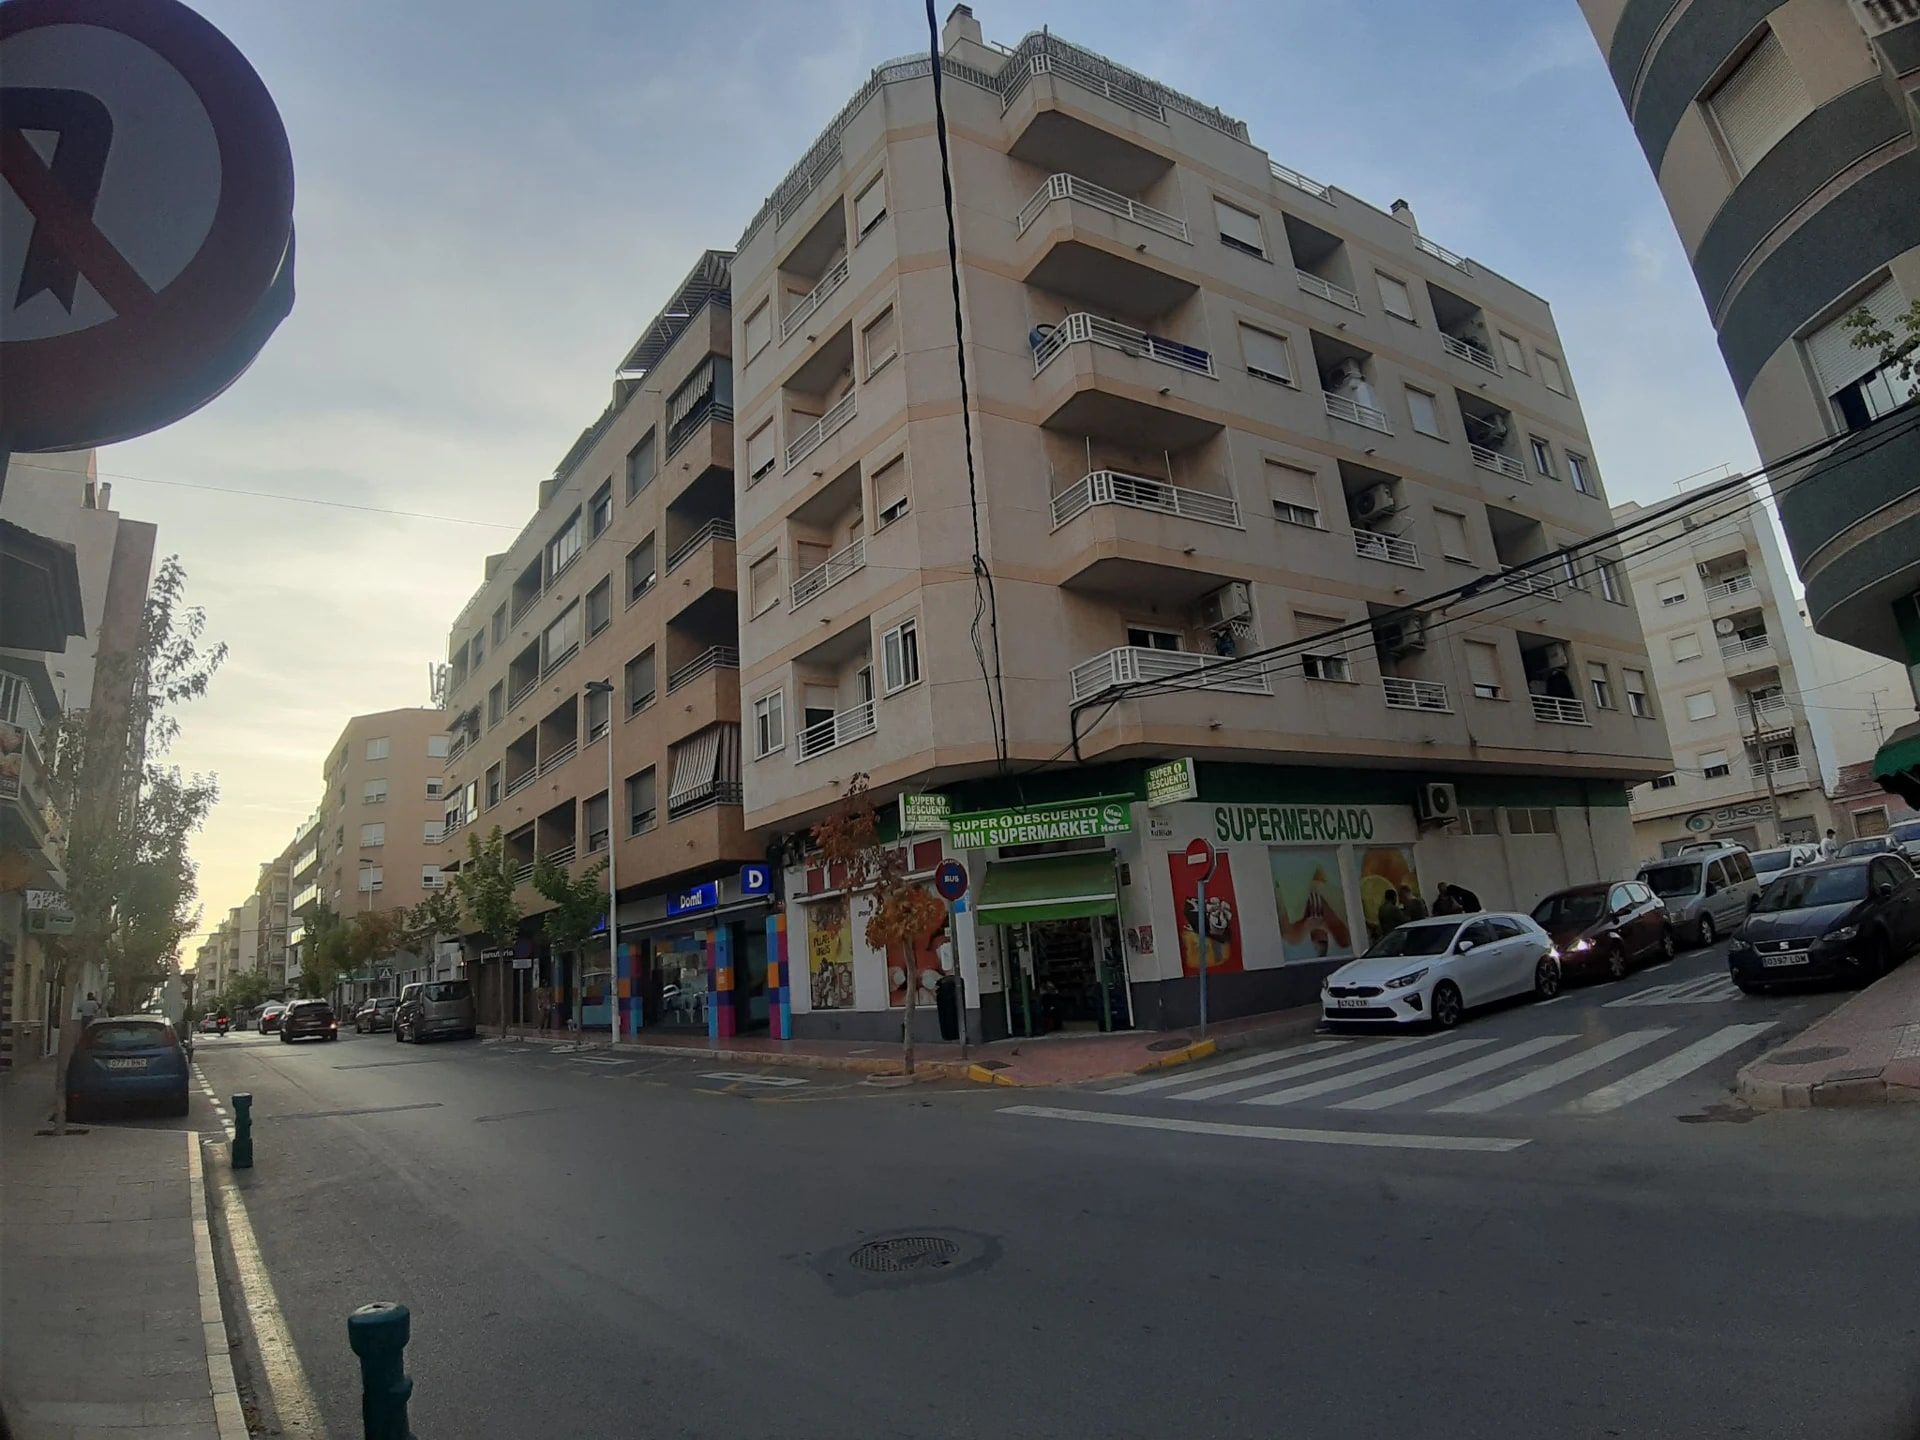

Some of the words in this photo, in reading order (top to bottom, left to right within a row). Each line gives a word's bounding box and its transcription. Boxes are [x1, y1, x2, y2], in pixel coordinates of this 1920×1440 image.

[1147, 772, 1187, 790] DESCUENTO
[1149, 766, 1172, 780] SUPER
[910, 796, 935, 805] SUPER
[906, 805, 951, 815] DESCUENTO
[952, 818, 998, 832] SUPER
[1014, 807, 1099, 825] DESCUENTO
[1214, 807, 1374, 842] SUPERMERCADO
[953, 830, 985, 849] MINI
[989, 819, 1099, 844] SUPERMARKET
[748, 869, 763, 889] D
[944, 875, 960, 883] BUS
